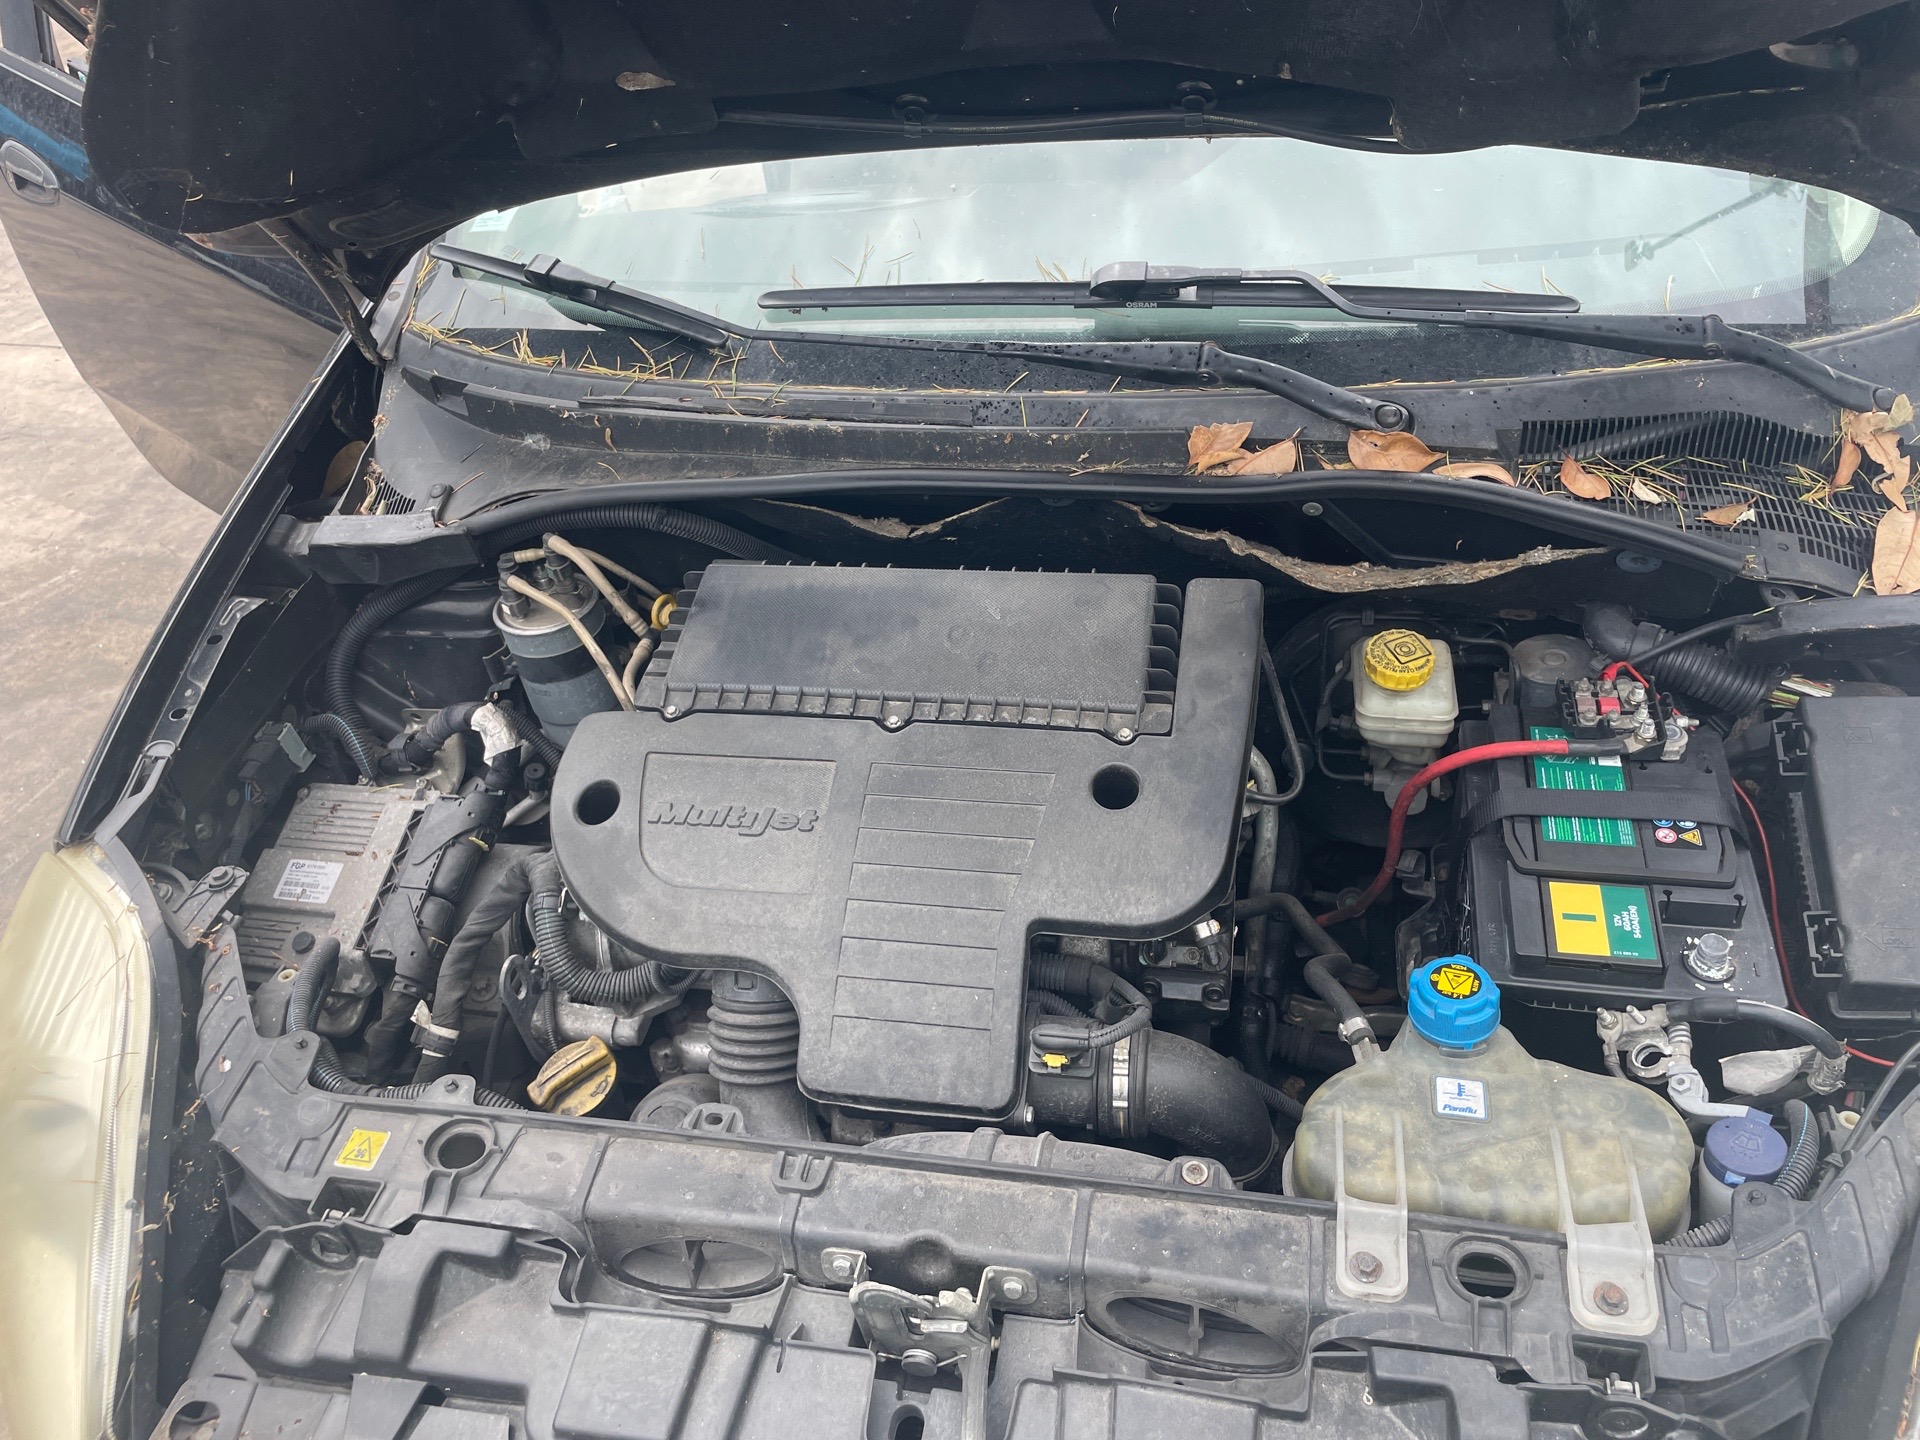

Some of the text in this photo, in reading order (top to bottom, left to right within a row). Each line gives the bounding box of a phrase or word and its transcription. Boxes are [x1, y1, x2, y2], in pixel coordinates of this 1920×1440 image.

[1126, 301, 1157, 309] OSRAM
[1613, 914, 1622, 927] 12V
[1621, 911, 1632, 931] 60AH
[1627, 905, 1642, 939] 540A(EN)
[1442, 1103, 1478, 1115] Paraflu
